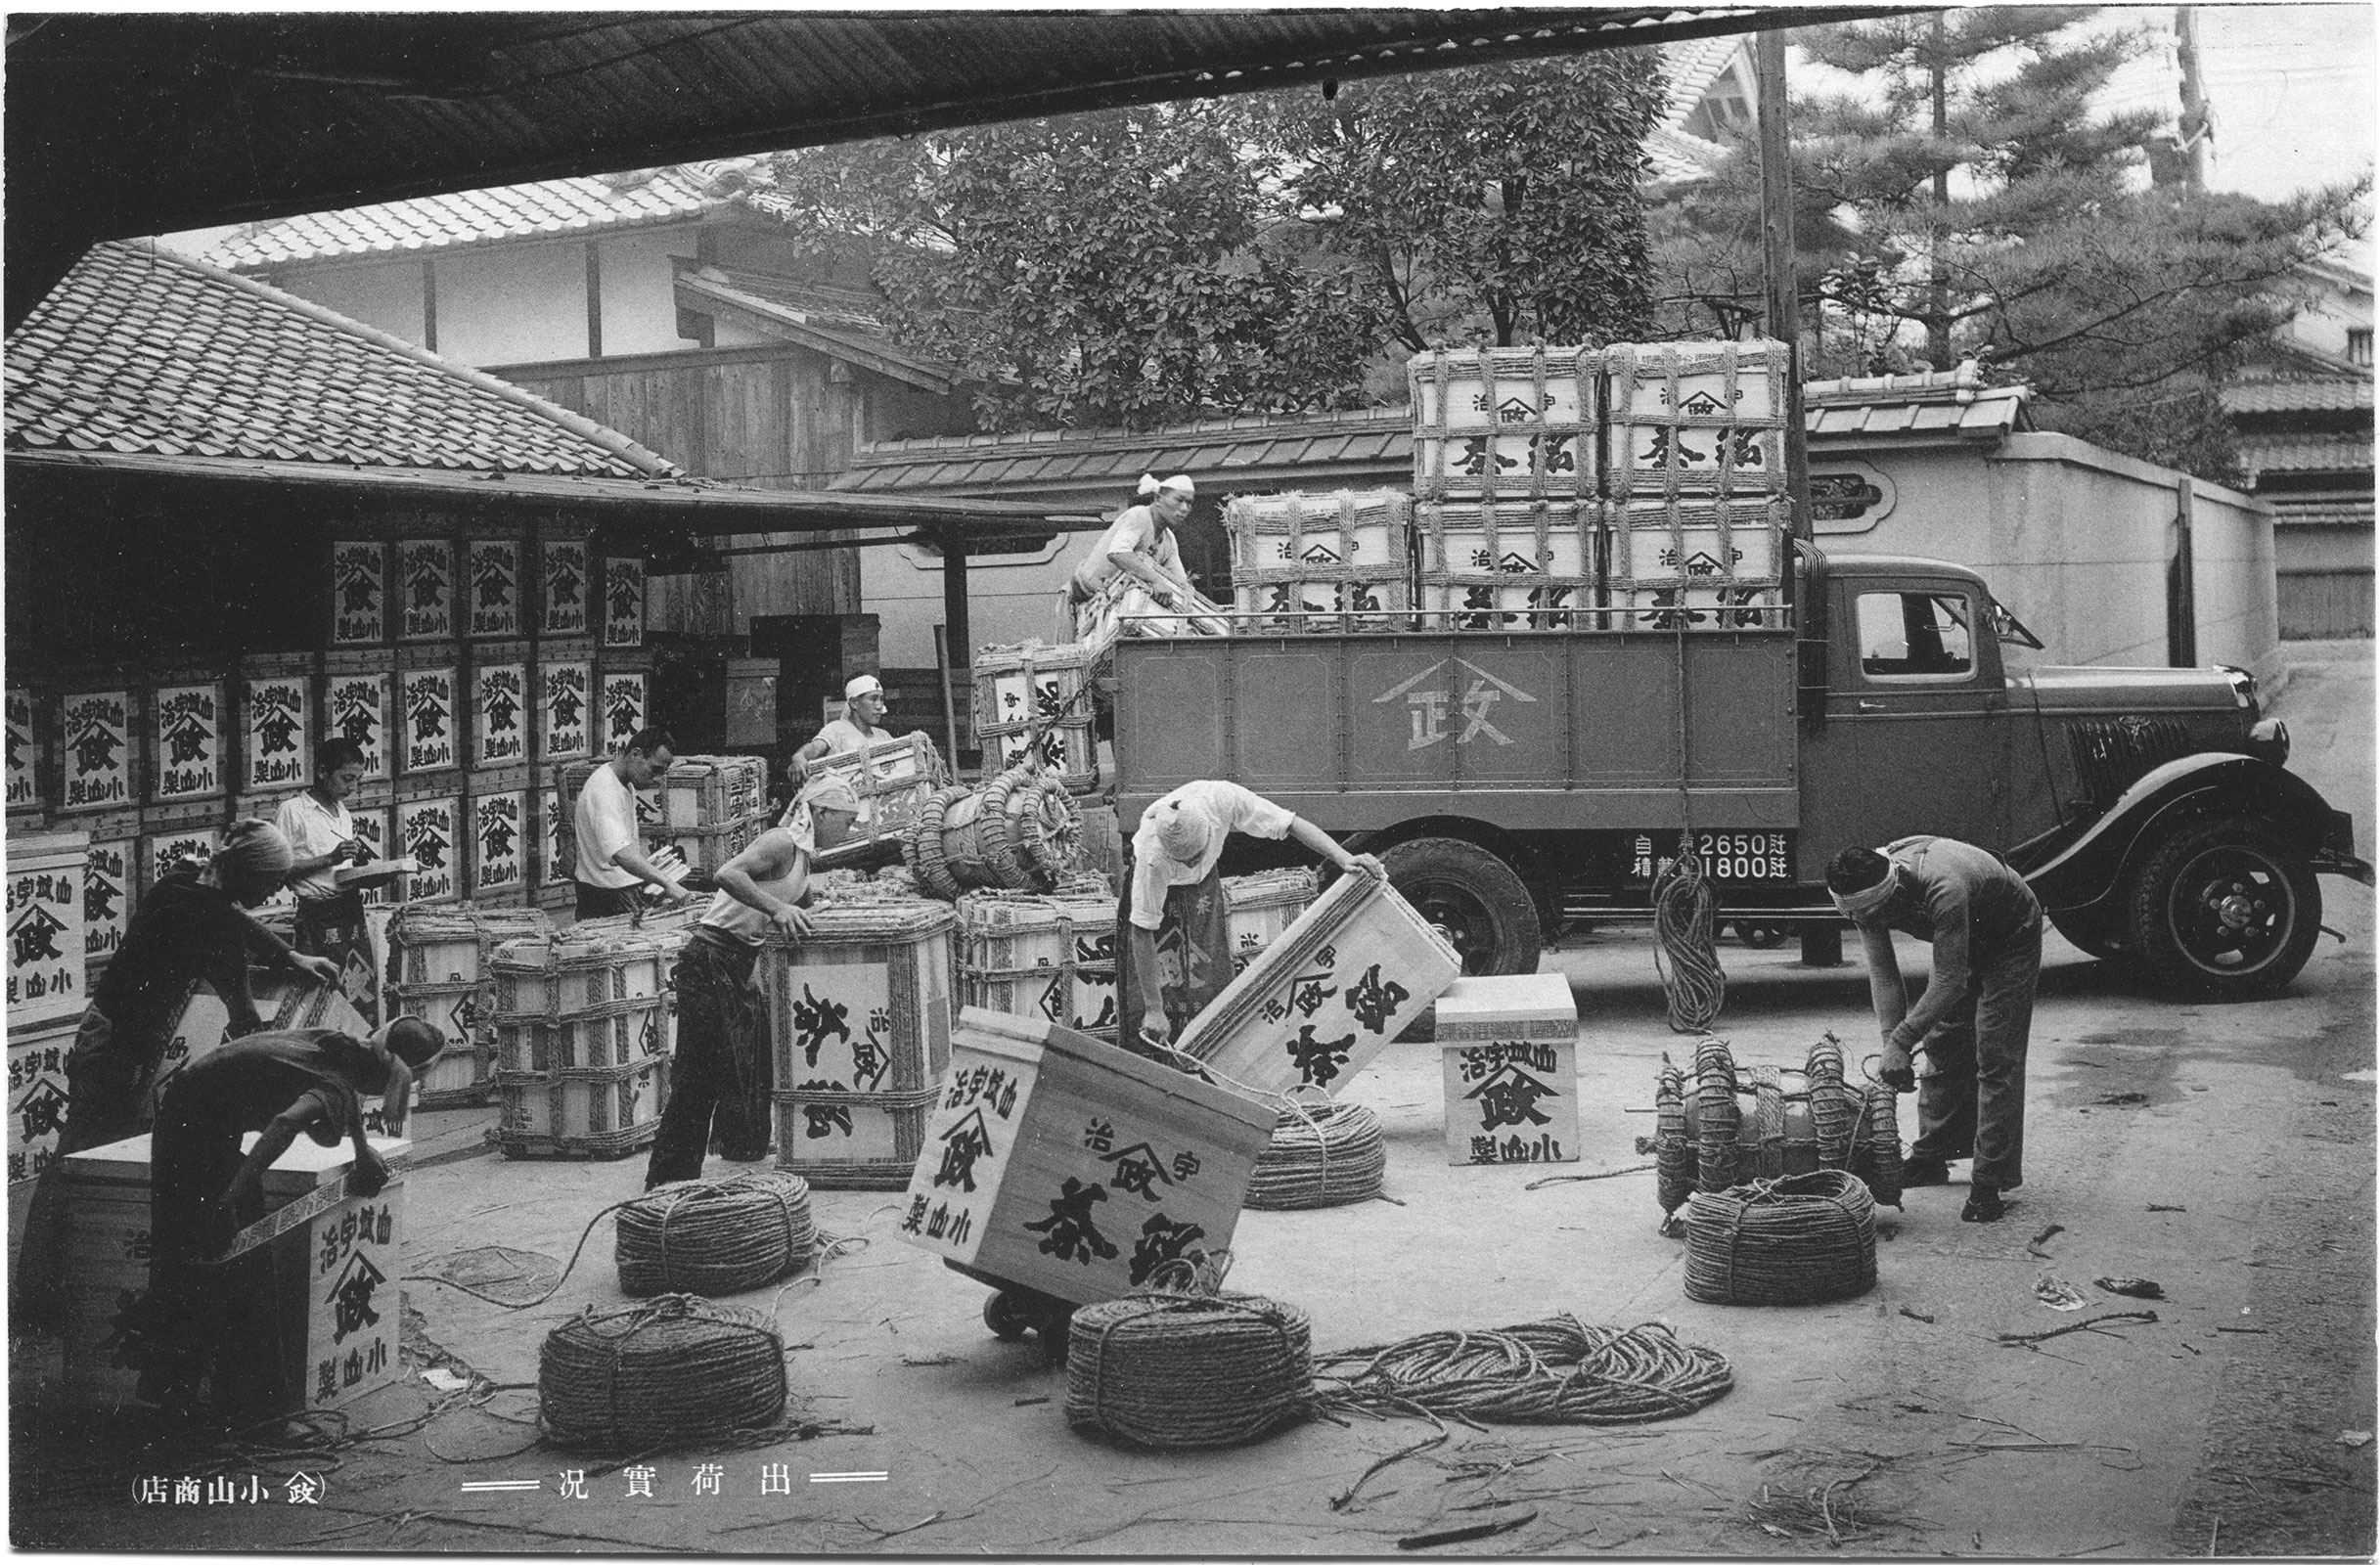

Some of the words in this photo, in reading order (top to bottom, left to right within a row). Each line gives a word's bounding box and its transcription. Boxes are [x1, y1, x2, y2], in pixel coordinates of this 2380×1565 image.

[1408, 681, 1514, 751] 政
[1460, 1041, 1557, 1082] 山城宇治
[1480, 1079, 1551, 1132] 政
[1469, 1133, 1562, 1163] 小山製
